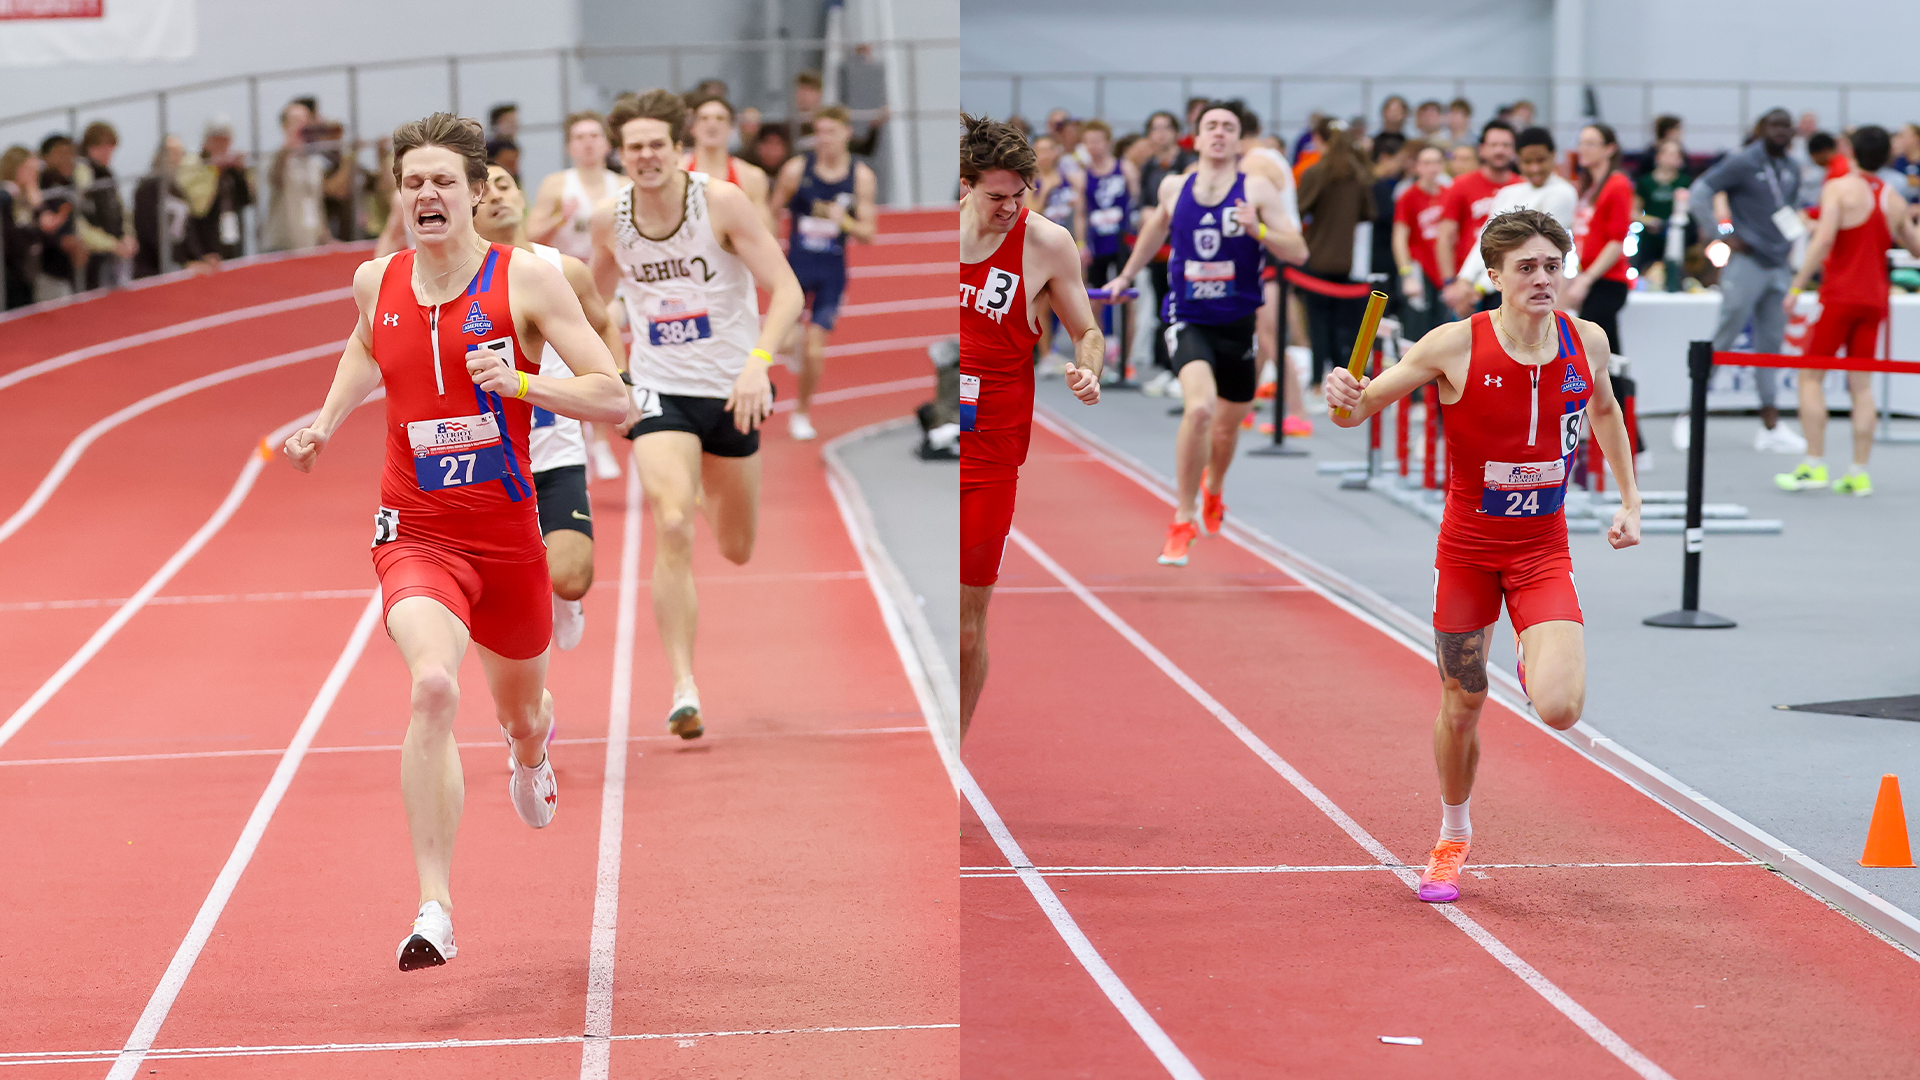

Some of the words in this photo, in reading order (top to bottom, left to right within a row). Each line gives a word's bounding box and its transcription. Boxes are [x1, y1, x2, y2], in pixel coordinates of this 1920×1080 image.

[690, 255, 717, 282] 2
[987, 273, 1013, 309] 3
[464, 321, 492, 331] AMERICAN
[656, 318, 700, 344] 384
[1562, 381, 1587, 391] AMERICAN
[637, 388, 652, 414] 2
[434, 430, 472, 440] PATRIOT
[435, 436, 474, 445] LEAGUE
[1565, 414, 1580, 451] 8
[439, 453, 477, 486] 27
[1504, 490, 1540, 516] 24
[375, 509, 391, 546] 5
